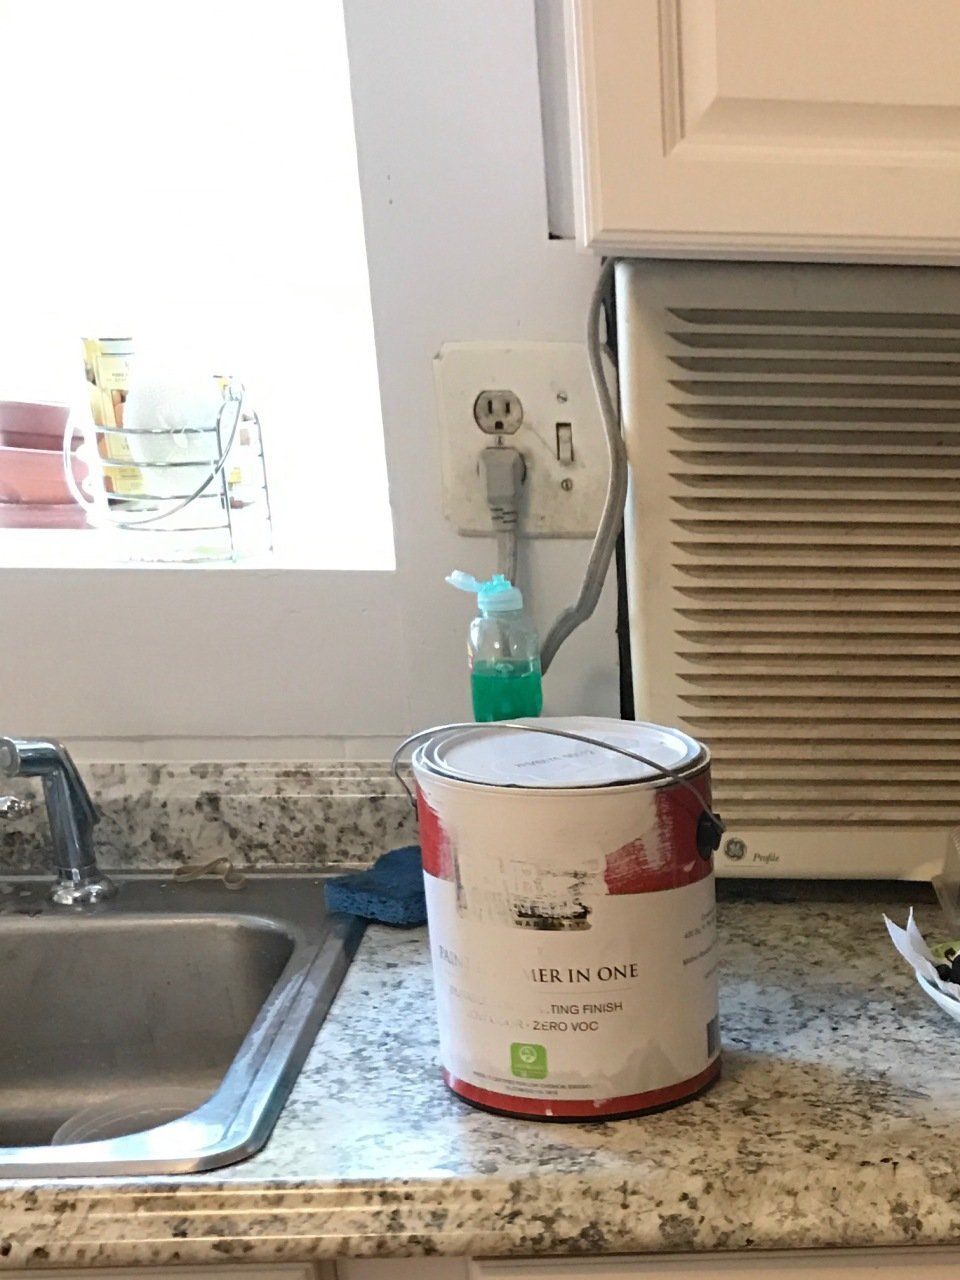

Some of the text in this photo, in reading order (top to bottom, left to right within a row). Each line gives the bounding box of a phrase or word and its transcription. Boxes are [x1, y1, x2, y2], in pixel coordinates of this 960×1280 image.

[568, 967, 591, 983] IN
[597, 963, 639, 981] ONE
[550, 1002, 623, 1015] TING FINISH
[532, 1020, 568, 1032] ZERO
[571, 1020, 599, 1032] VOC
